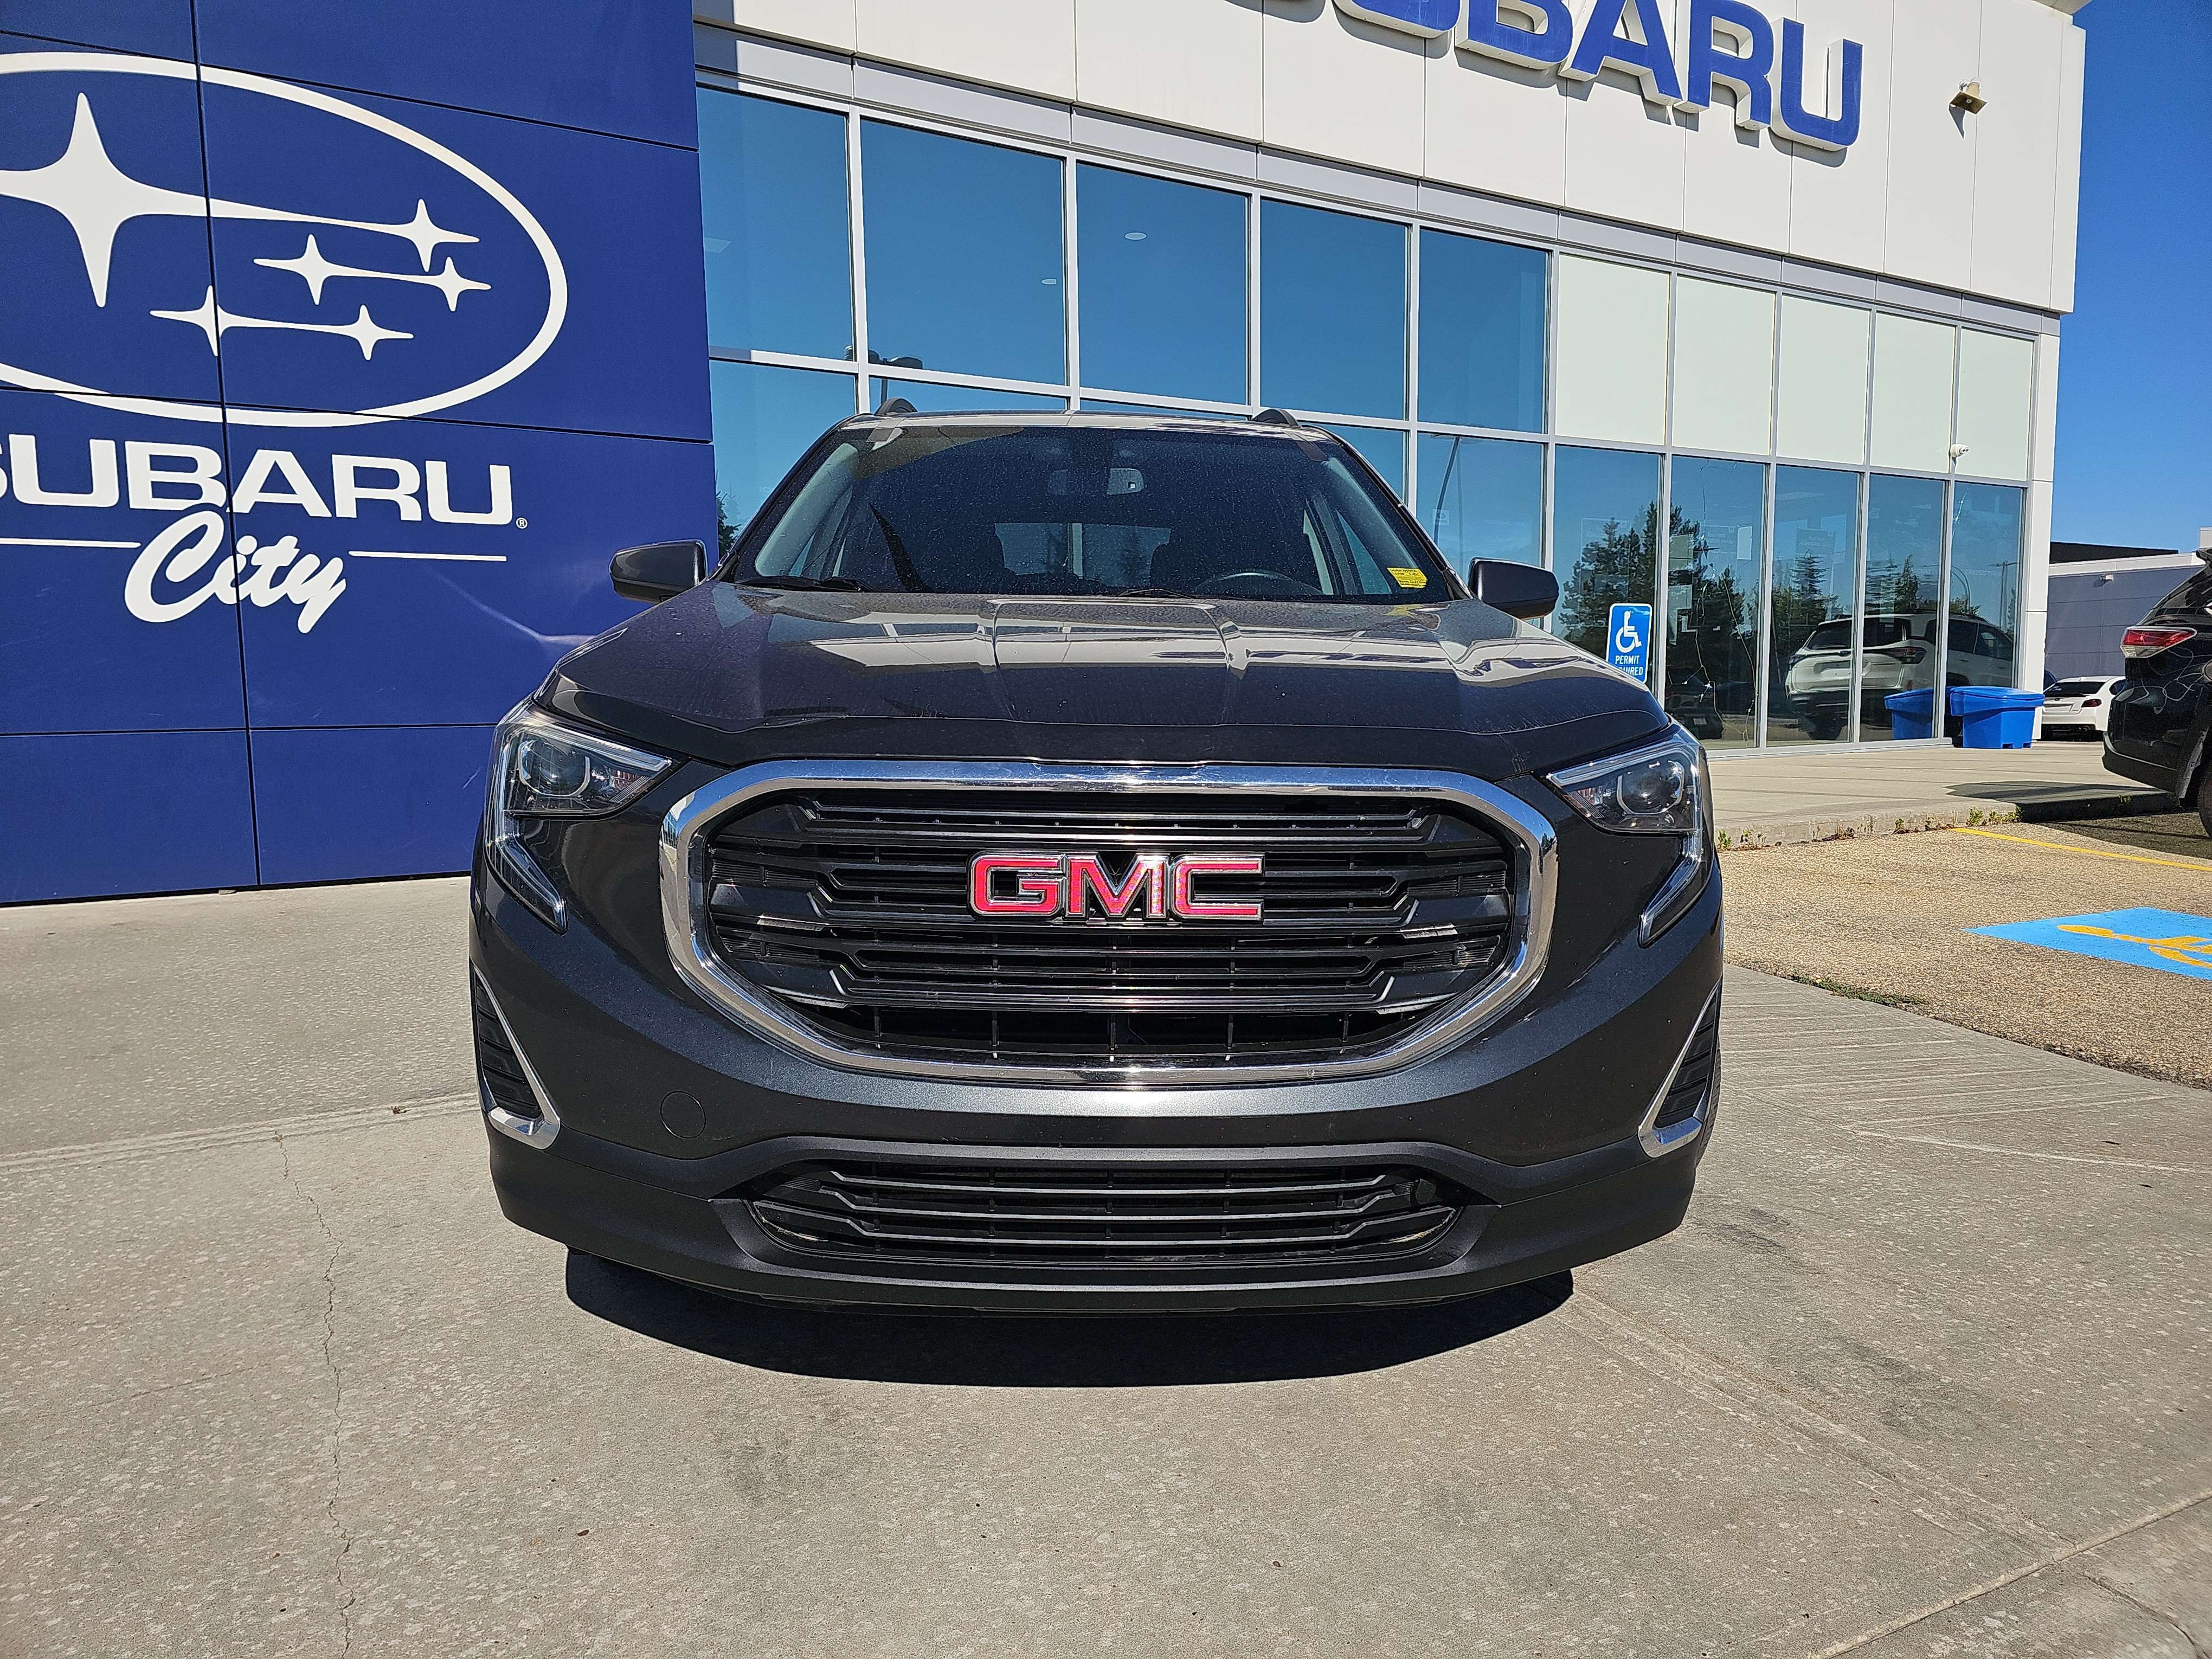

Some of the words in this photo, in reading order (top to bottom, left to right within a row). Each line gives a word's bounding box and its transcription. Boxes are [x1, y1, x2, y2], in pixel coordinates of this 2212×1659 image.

[0, 434, 513, 525] UBARU
[125, 511, 346, 633] City
[1615, 655, 1640, 665] PERMIT
[970, 852, 1265, 919] GMC
